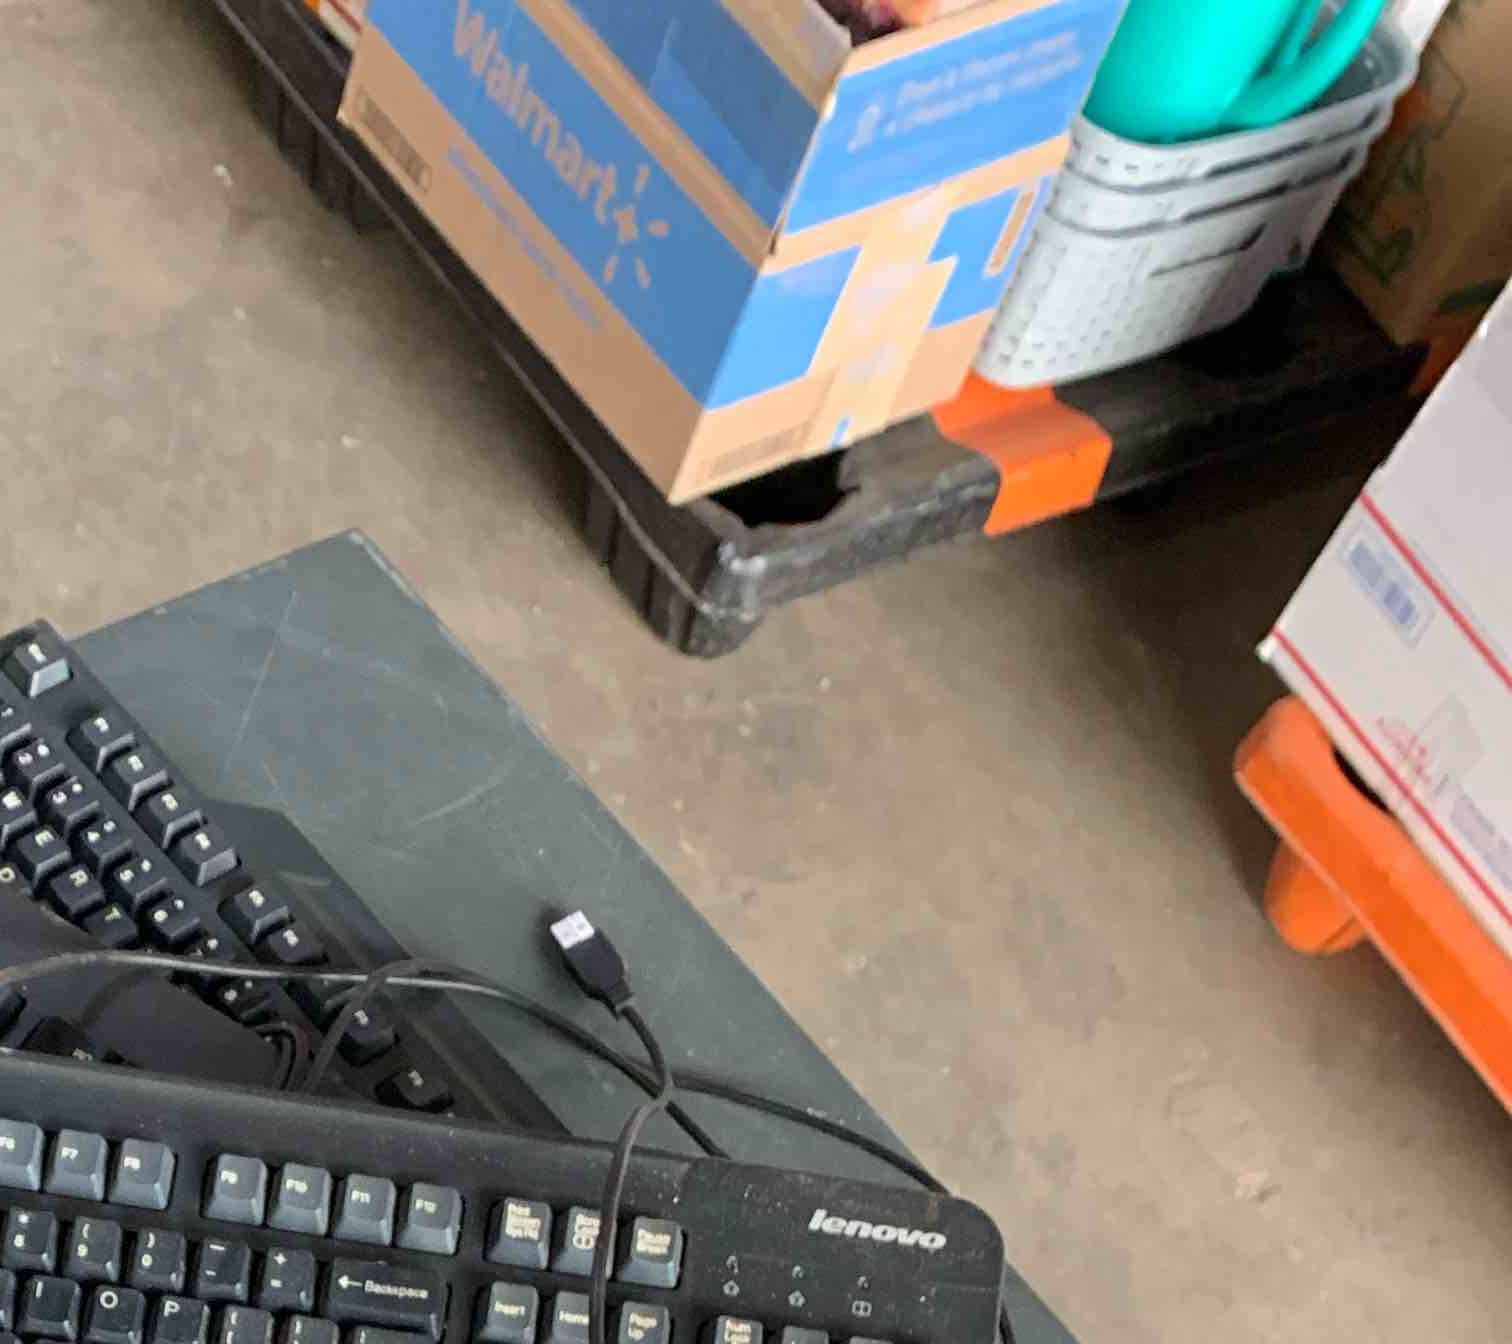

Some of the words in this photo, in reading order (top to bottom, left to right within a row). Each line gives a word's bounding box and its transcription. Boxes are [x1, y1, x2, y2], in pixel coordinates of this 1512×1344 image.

[453, 0, 615, 225] Walmart
[61, 1146, 79, 1160] F7
[808, 1209, 947, 1249] lenovo
[14, 1234, 25, 1247] 8
[77, 1244, 88, 1257] 9
[142, 1253, 152, 1267] 0
[35, 1282, 43, 1298] I
[100, 1291, 118, 1308] O
[165, 1301, 180, 1318] P
